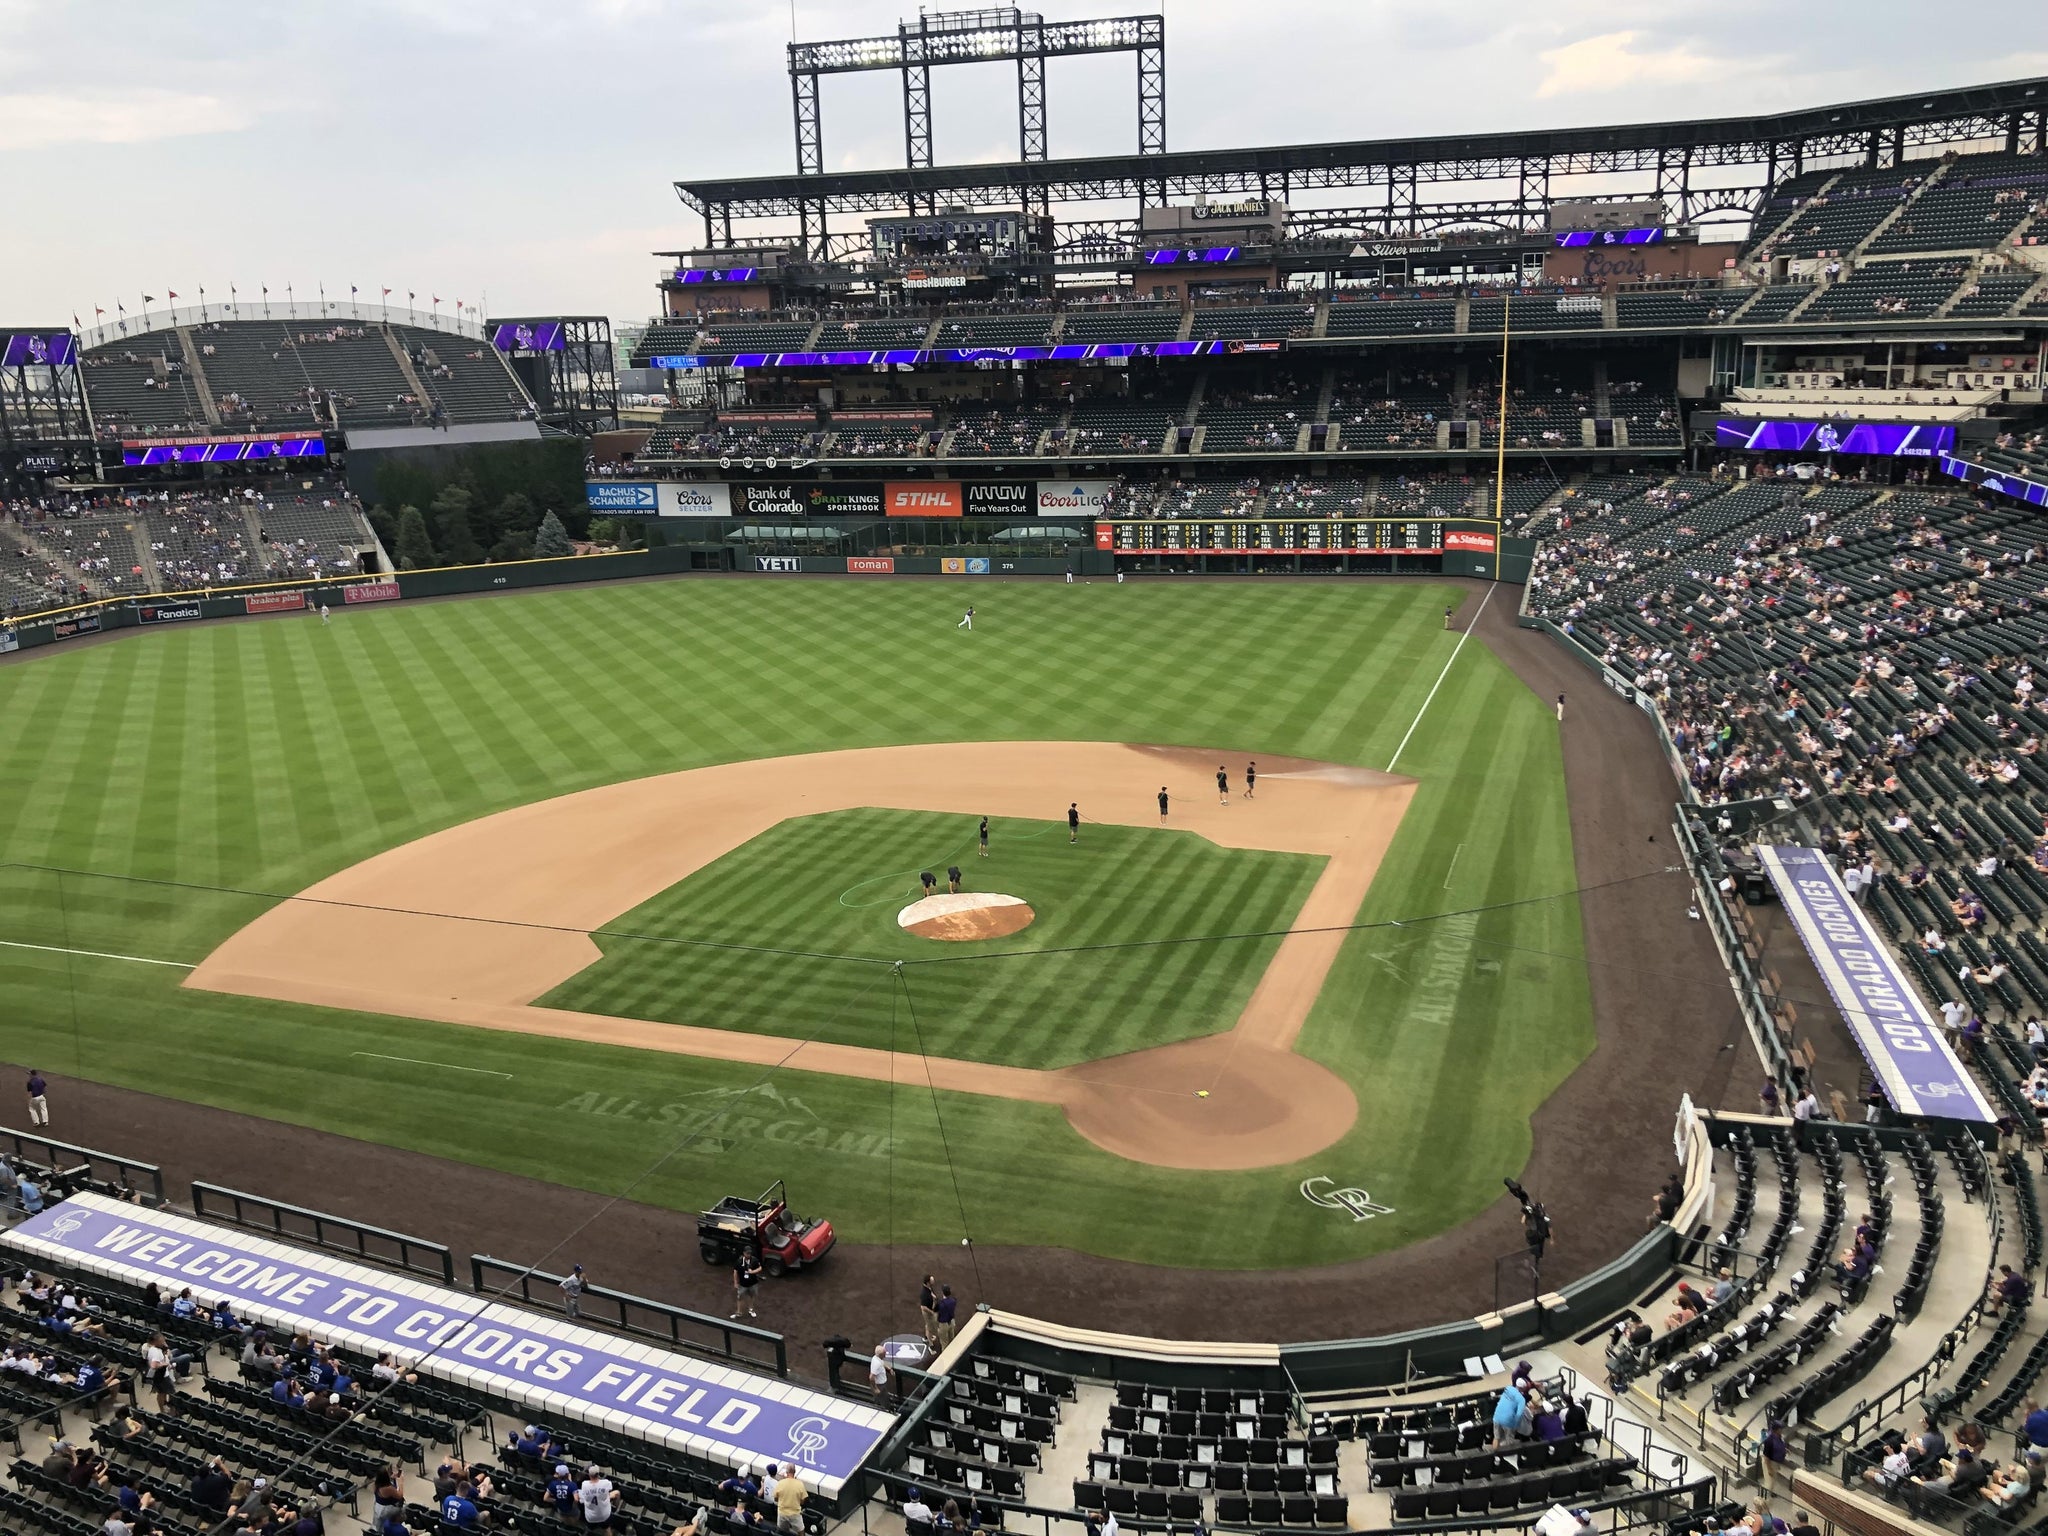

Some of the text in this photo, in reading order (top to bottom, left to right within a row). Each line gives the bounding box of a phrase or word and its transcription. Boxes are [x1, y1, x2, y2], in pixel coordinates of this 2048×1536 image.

[1210, 200, 1264, 214] JACK DANIEL'S
[1370, 244, 1408, 256] Silver
[1584, 253, 1646, 276] Coors
[599, 488, 636, 496] BACHUS
[676, 490, 712, 505] Coors
[748, 486, 791, 499] Bank of
[589, 497, 636, 506] SCHANKER
[811, 495, 879, 505] DRAFTKINGS
[895, 493, 952, 506] STIHL
[1039, 493, 1079, 509] Coors
[748, 500, 803, 512] Colorado
[988, 504, 1010, 513] Years
[759, 558, 797, 570] YETI
[854, 560, 888, 569] roman
[360, 586, 396, 598] Mobile
[250, 593, 300, 605] brakes plus
[157, 607, 199, 619] Fanatics
[1800, 879, 1932, 1052] COLORADO ROCKIES
[762, 1118, 904, 1158] GAME
[95, 1224, 762, 1435] WELCOME TO COORS FIELD
[591, 1495, 598, 1506] 4
[447, 1508, 458, 1520] 13
